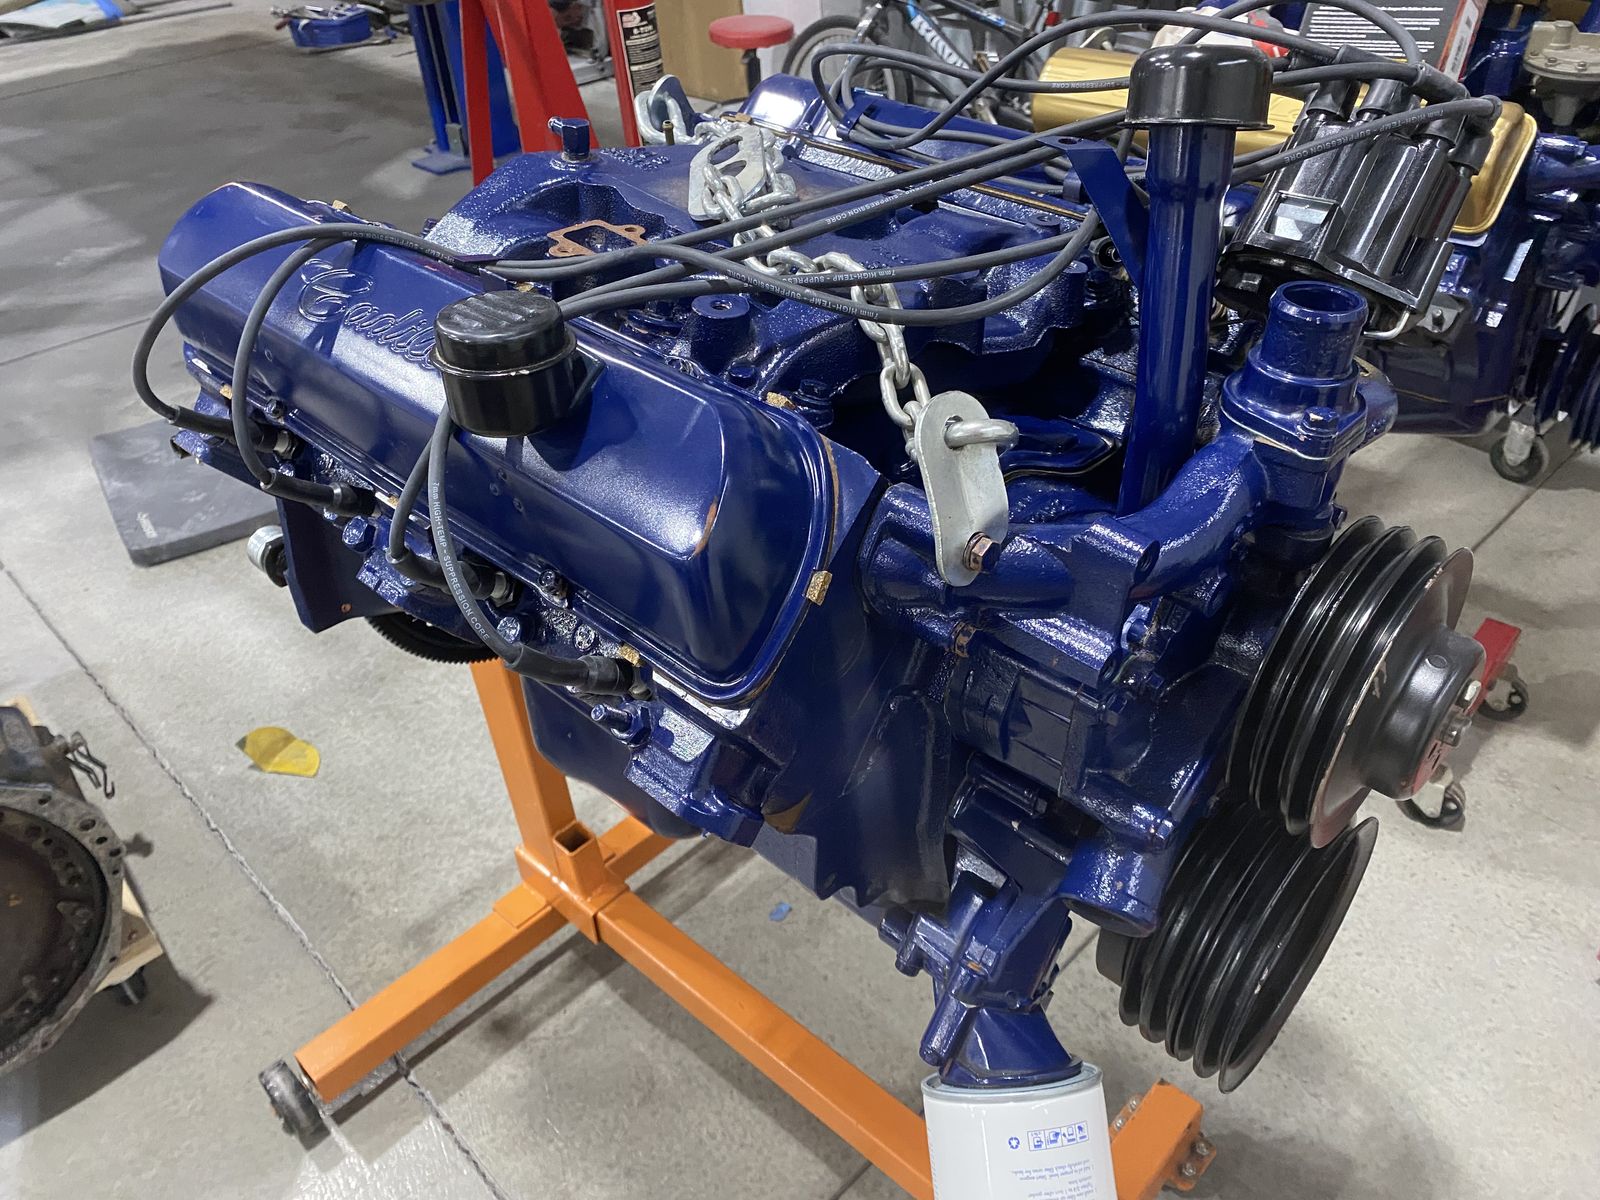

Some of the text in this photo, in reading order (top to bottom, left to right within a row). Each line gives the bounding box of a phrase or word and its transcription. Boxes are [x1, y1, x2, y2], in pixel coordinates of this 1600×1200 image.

[1310, 129, 1371, 156] SUPPRESSION
[1284, 149, 1309, 164] CORE
[848, 194, 899, 217] SUPPRESSION
[826, 213, 847, 225] CORE
[727, 268, 750, 281] CORE
[832, 271, 877, 282] HIGH-TEMP
[877, 269, 896, 278] 7mm
[750, 277, 802, 299] SUPPRESSION
[808, 297, 859, 316] HIGH-TEMP
[858, 309, 879, 320] 7mm
[432, 482, 440, 500] 7mm
[432, 501, 447, 548] HIGH-TEMP
[443, 555, 474, 616] SUPPRESSION
[470, 616, 490, 641] CORE
